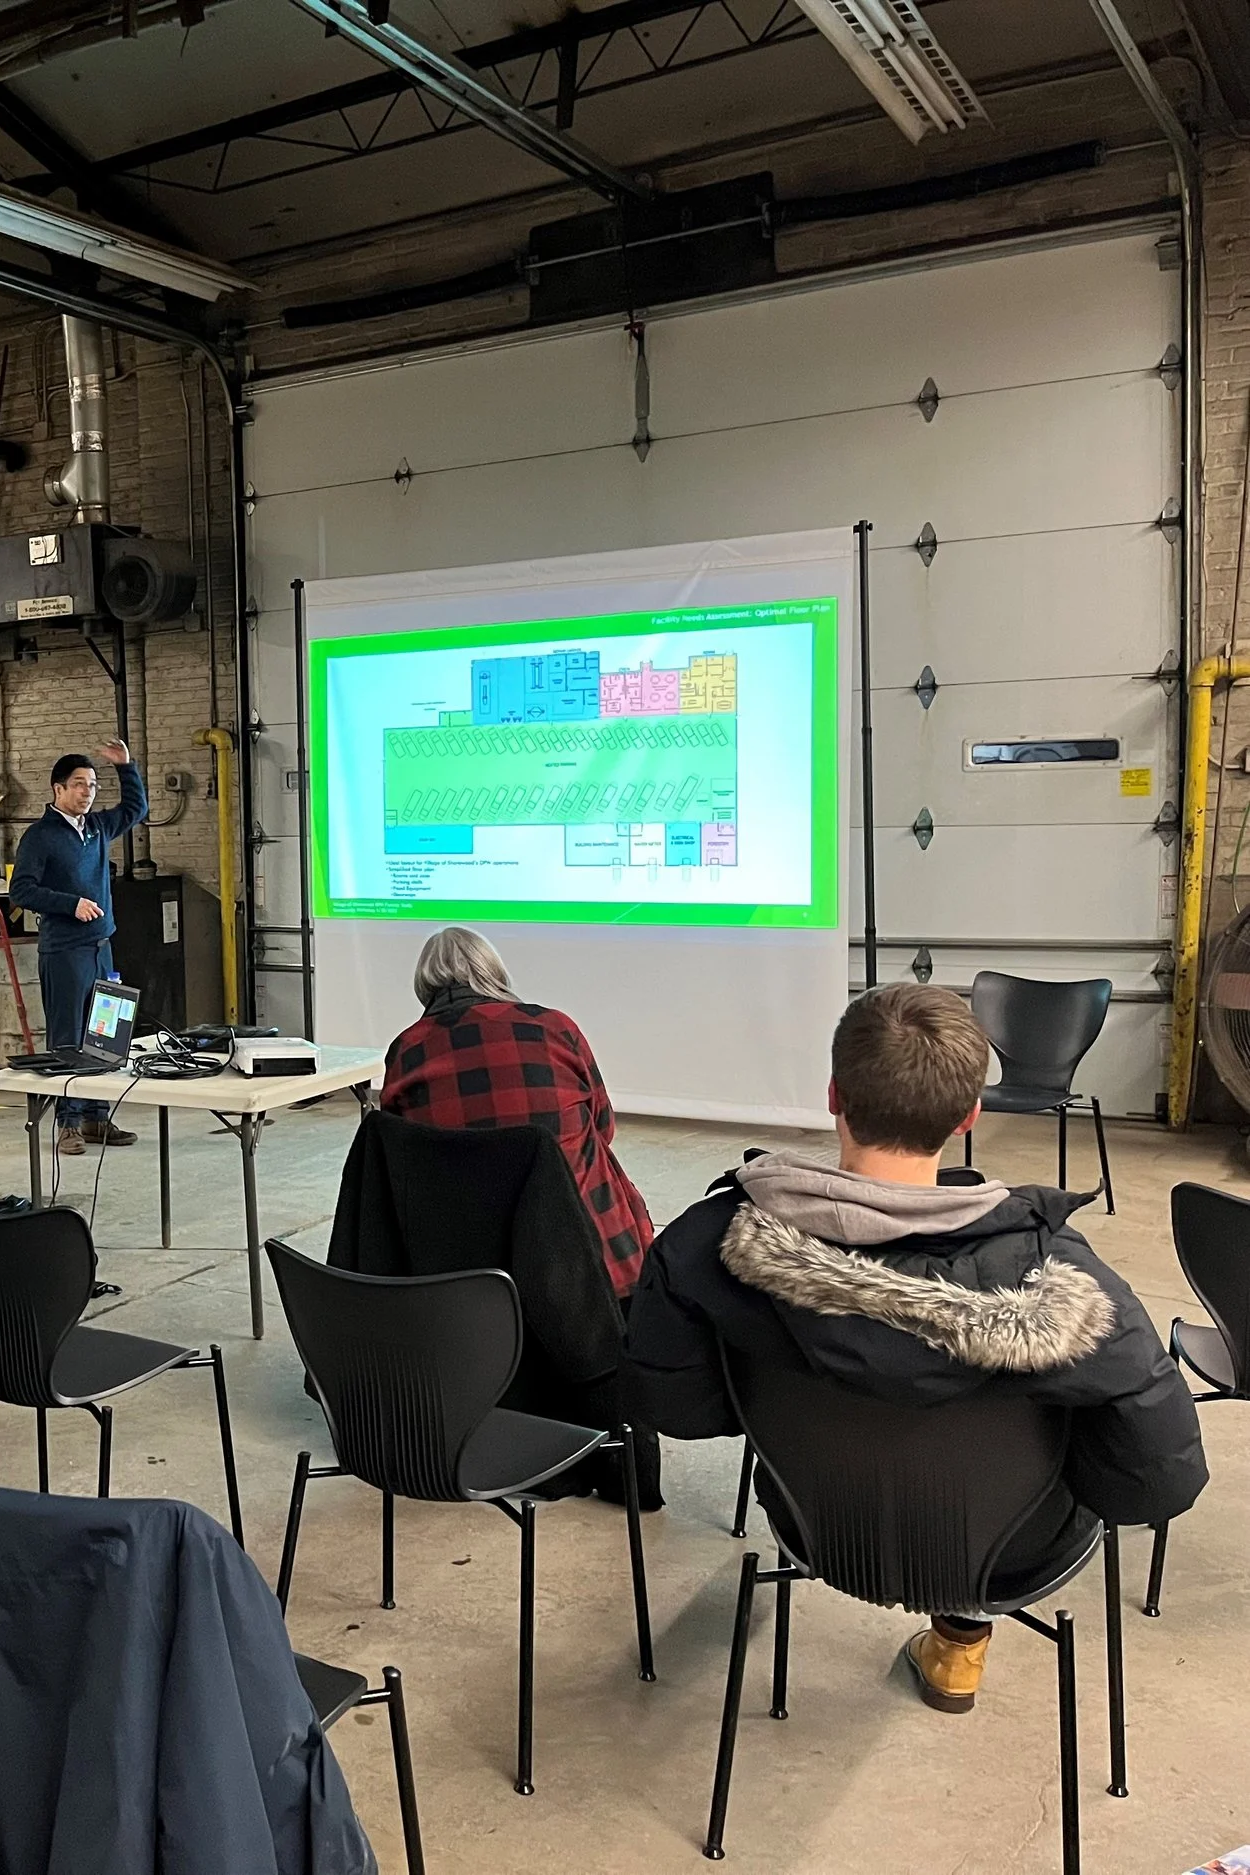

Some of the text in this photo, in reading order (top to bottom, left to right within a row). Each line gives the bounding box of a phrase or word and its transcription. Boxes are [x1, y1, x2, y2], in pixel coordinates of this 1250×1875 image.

[651, 615, 680, 625] Facility
[706, 611, 752, 621] Assessment:
[755, 607, 787, 617] Optimal
[789, 605, 809, 614] Floor
